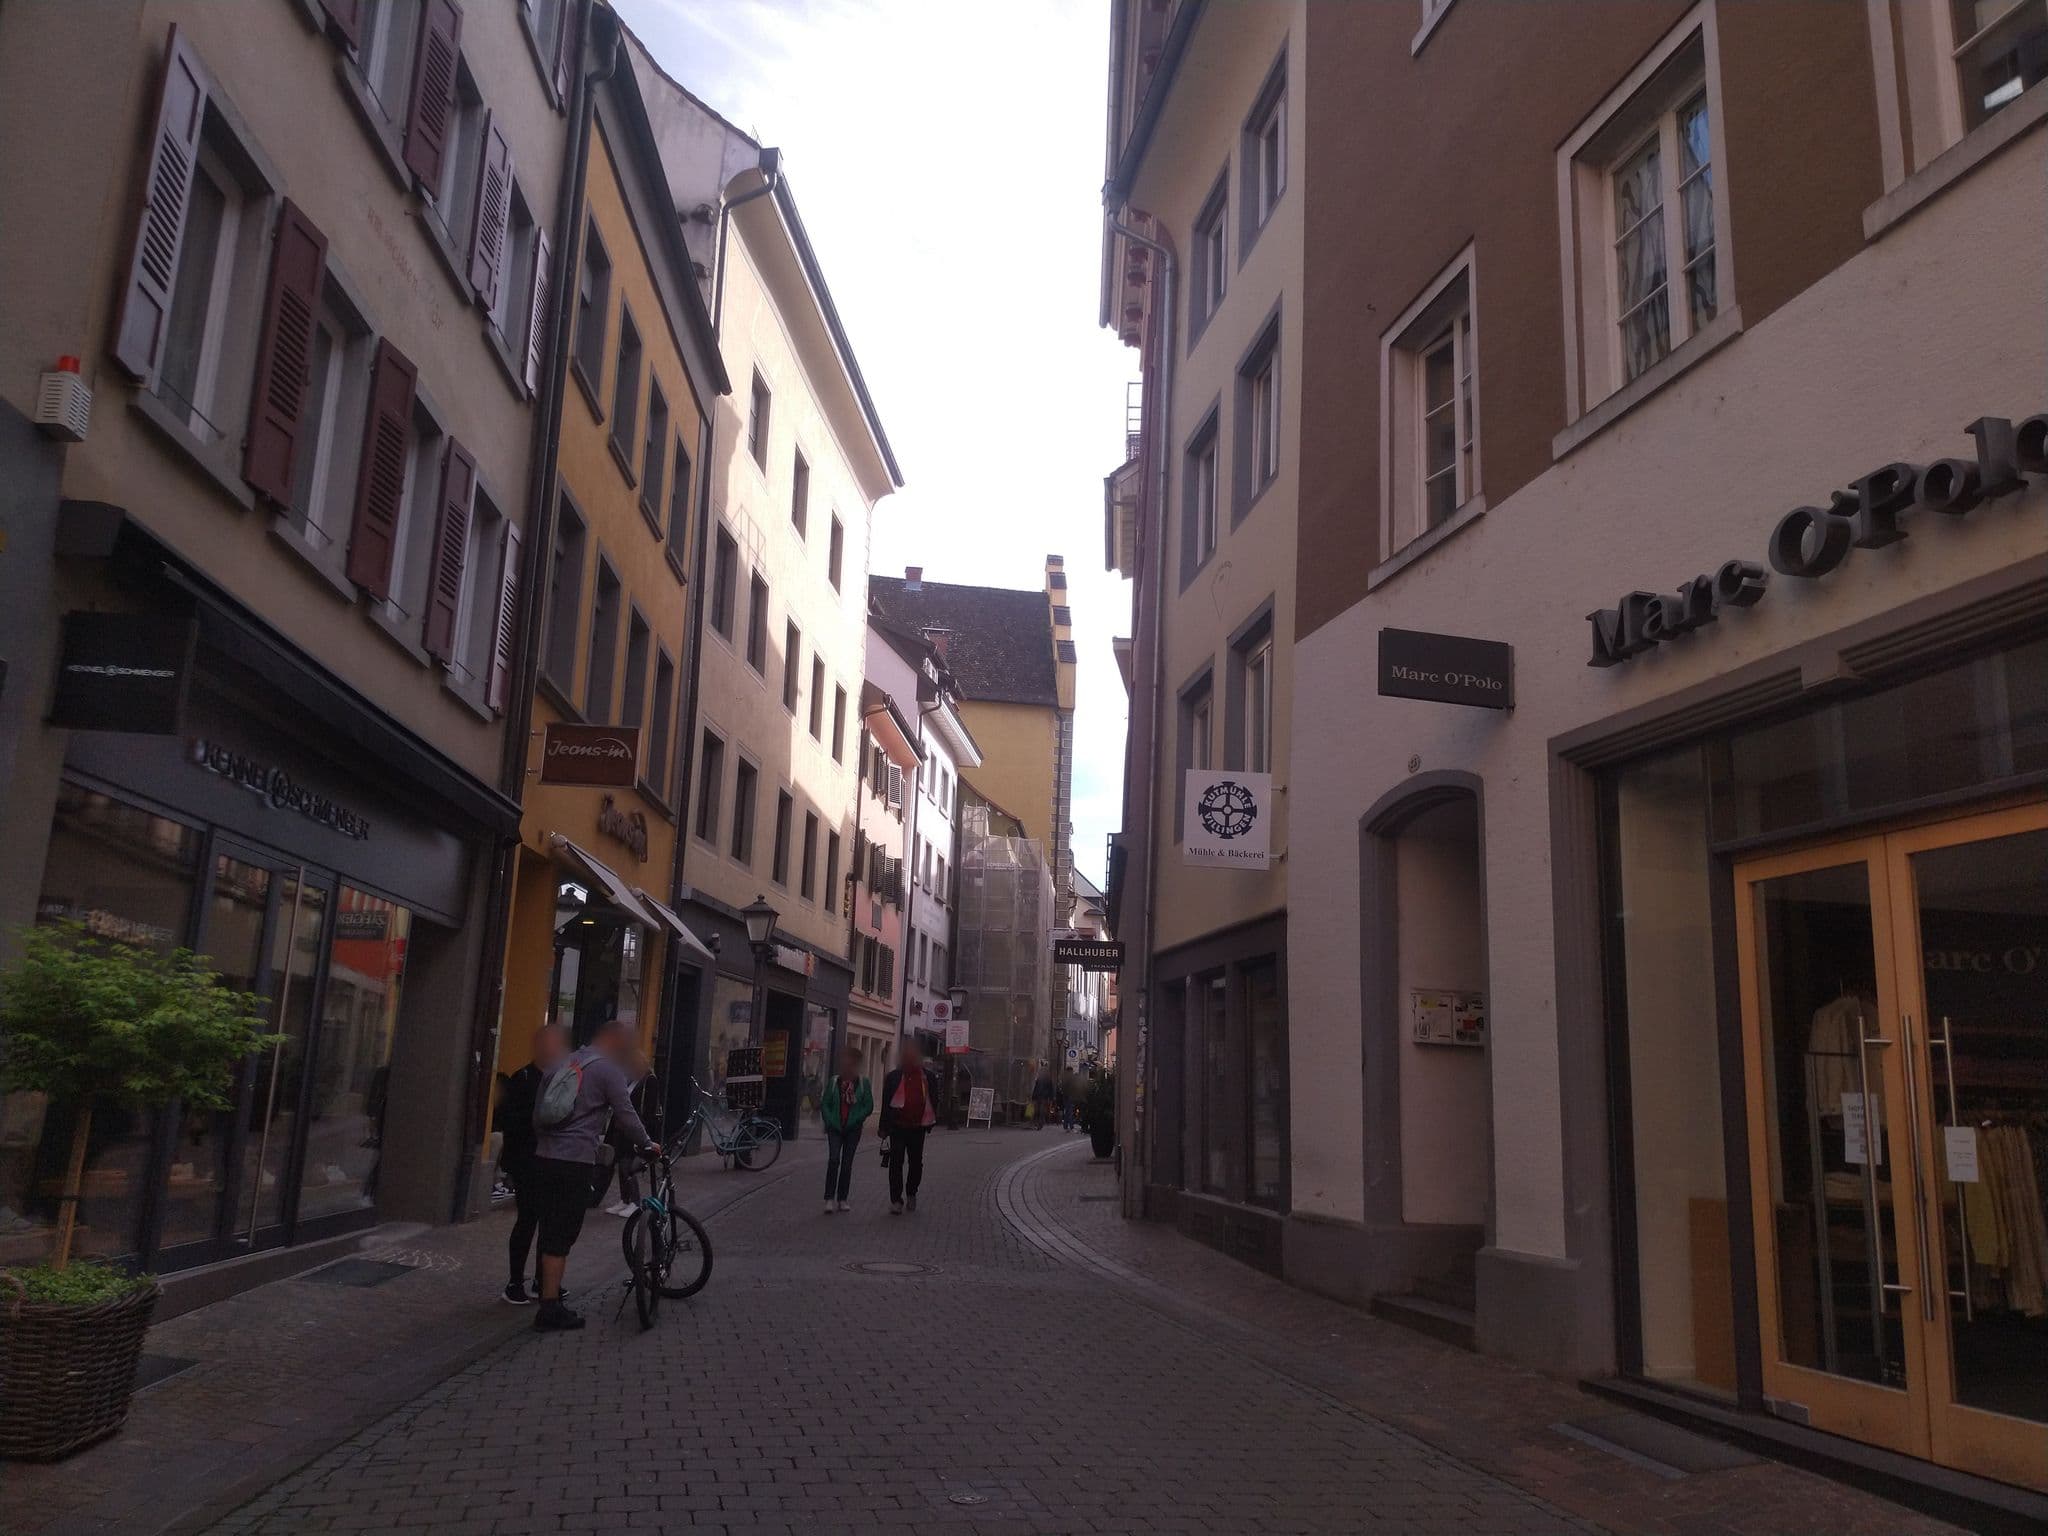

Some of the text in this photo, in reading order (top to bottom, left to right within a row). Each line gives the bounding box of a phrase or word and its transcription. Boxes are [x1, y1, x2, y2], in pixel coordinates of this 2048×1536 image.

[1586, 414, 2048, 668] Marc O'Polo
[1391, 665, 1503, 690] Marc O'Polo
[548, 740, 625, 759] Jeans-in
[1204, 812, 1251, 834] VILLINGEN
[1189, 847, 1265, 859] Mühle & Bäckerei
[1058, 946, 1119, 958] HALLHUBER
[1926, 951, 1993, 973] arc
